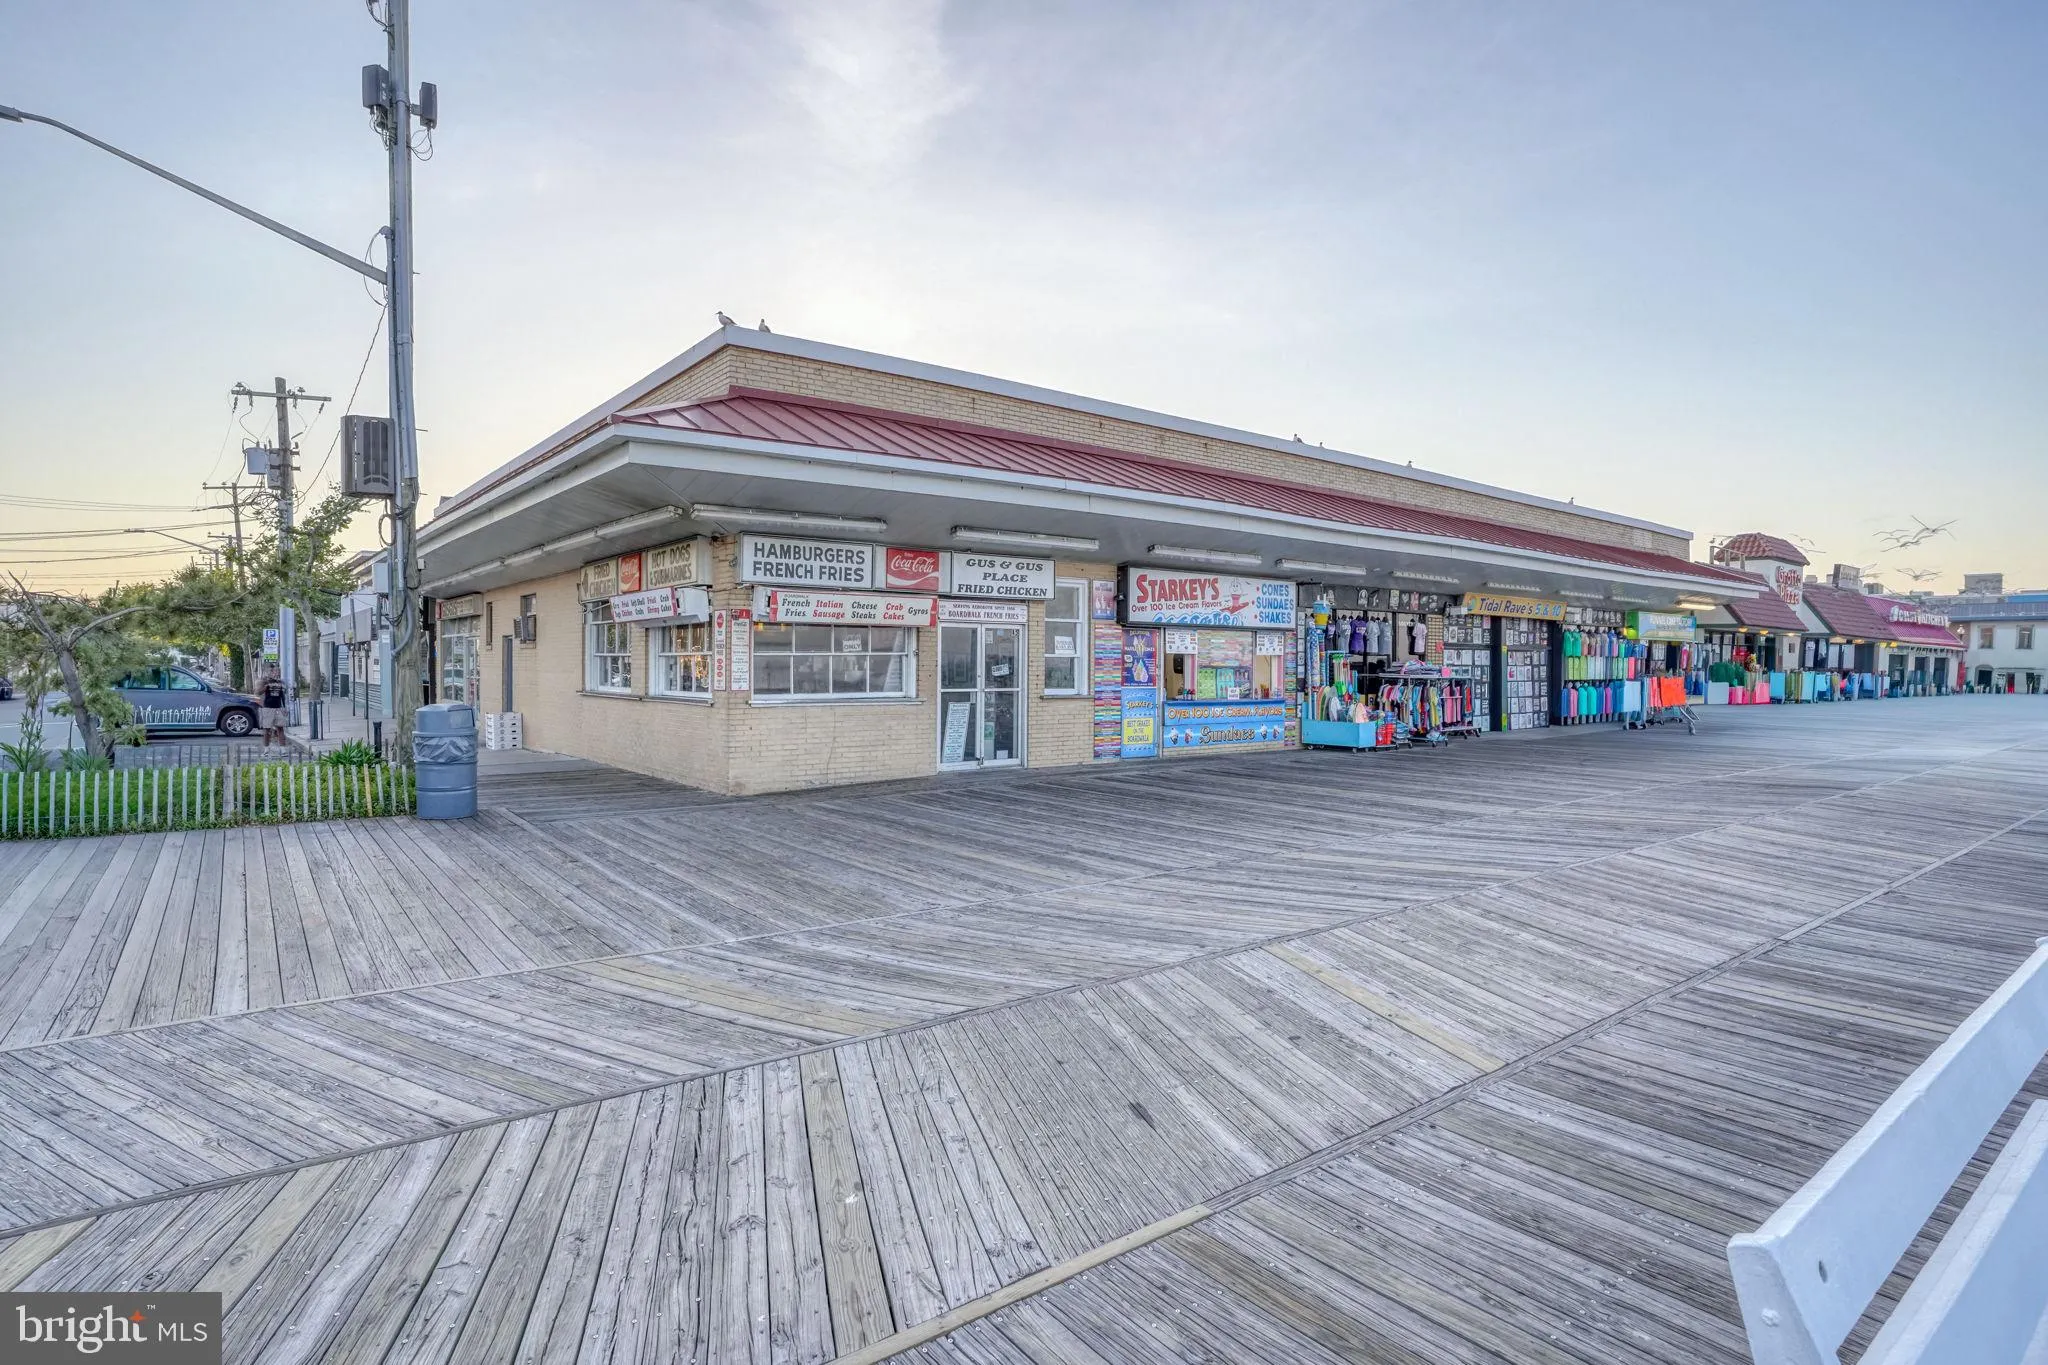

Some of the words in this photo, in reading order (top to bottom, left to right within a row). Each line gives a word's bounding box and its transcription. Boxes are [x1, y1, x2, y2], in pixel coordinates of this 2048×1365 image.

[651, 549, 666, 569] HOT
[669, 543, 691, 563] DOGS
[753, 541, 866, 566] HAMBURGERS
[593, 562, 611, 580] FRIED
[752, 560, 814, 580] FRENCH
[818, 564, 865, 583] FRIES
[891, 554, 935, 573] Coca-Cola
[966, 558, 996, 568] GUS
[999, 560, 1012, 569] &
[1015, 562, 1043, 572] GUS
[653, 563, 692, 586] SUBMARINES
[982, 572, 1028, 583] PLACE
[957, 583, 994, 594] FRIED
[996, 585, 1048, 597] CHICKEN
[1136, 574, 1220, 604] STARKEY'S
[1261, 583, 1290, 597] CONES
[782, 598, 811, 608] French
[815, 600, 844, 609] Italian
[851, 601, 878, 610] Cheese
[885, 602, 904, 611] Crab
[907, 607, 929, 616] Gyros
[1131, 604, 1148, 612] Over
[1150, 603, 1163, 611] 100
[1165, 602, 1176, 610] Ice
[1256, 597, 1295, 611] SUNDAES
[1480, 597, 1503, 611] Tidal
[1503, 600, 1533, 615] Rave's
[1535, 602, 1541, 615] 5
[1542, 603, 1550, 616] &
[1552, 604, 1562, 617] 10
[785, 608, 806, 617] Fries
[812, 609, 846, 619] Sausage
[851, 611, 876, 619] Steaks
[883, 612, 904, 621] Cakes
[948, 610, 981, 618] BOARDWALK
[983, 611, 1003, 619] FRENCH
[1258, 611, 1292, 624] SHAKES
[1167, 708, 1189, 720] OVER
[1191, 707, 1209, 719] 100
[1211, 707, 1224, 718] ICE
[1225, 705, 1251, 717] CREAM
[1253, 704, 1283, 717] FLAVORS
[1199, 726, 1255, 744] Sundaes
